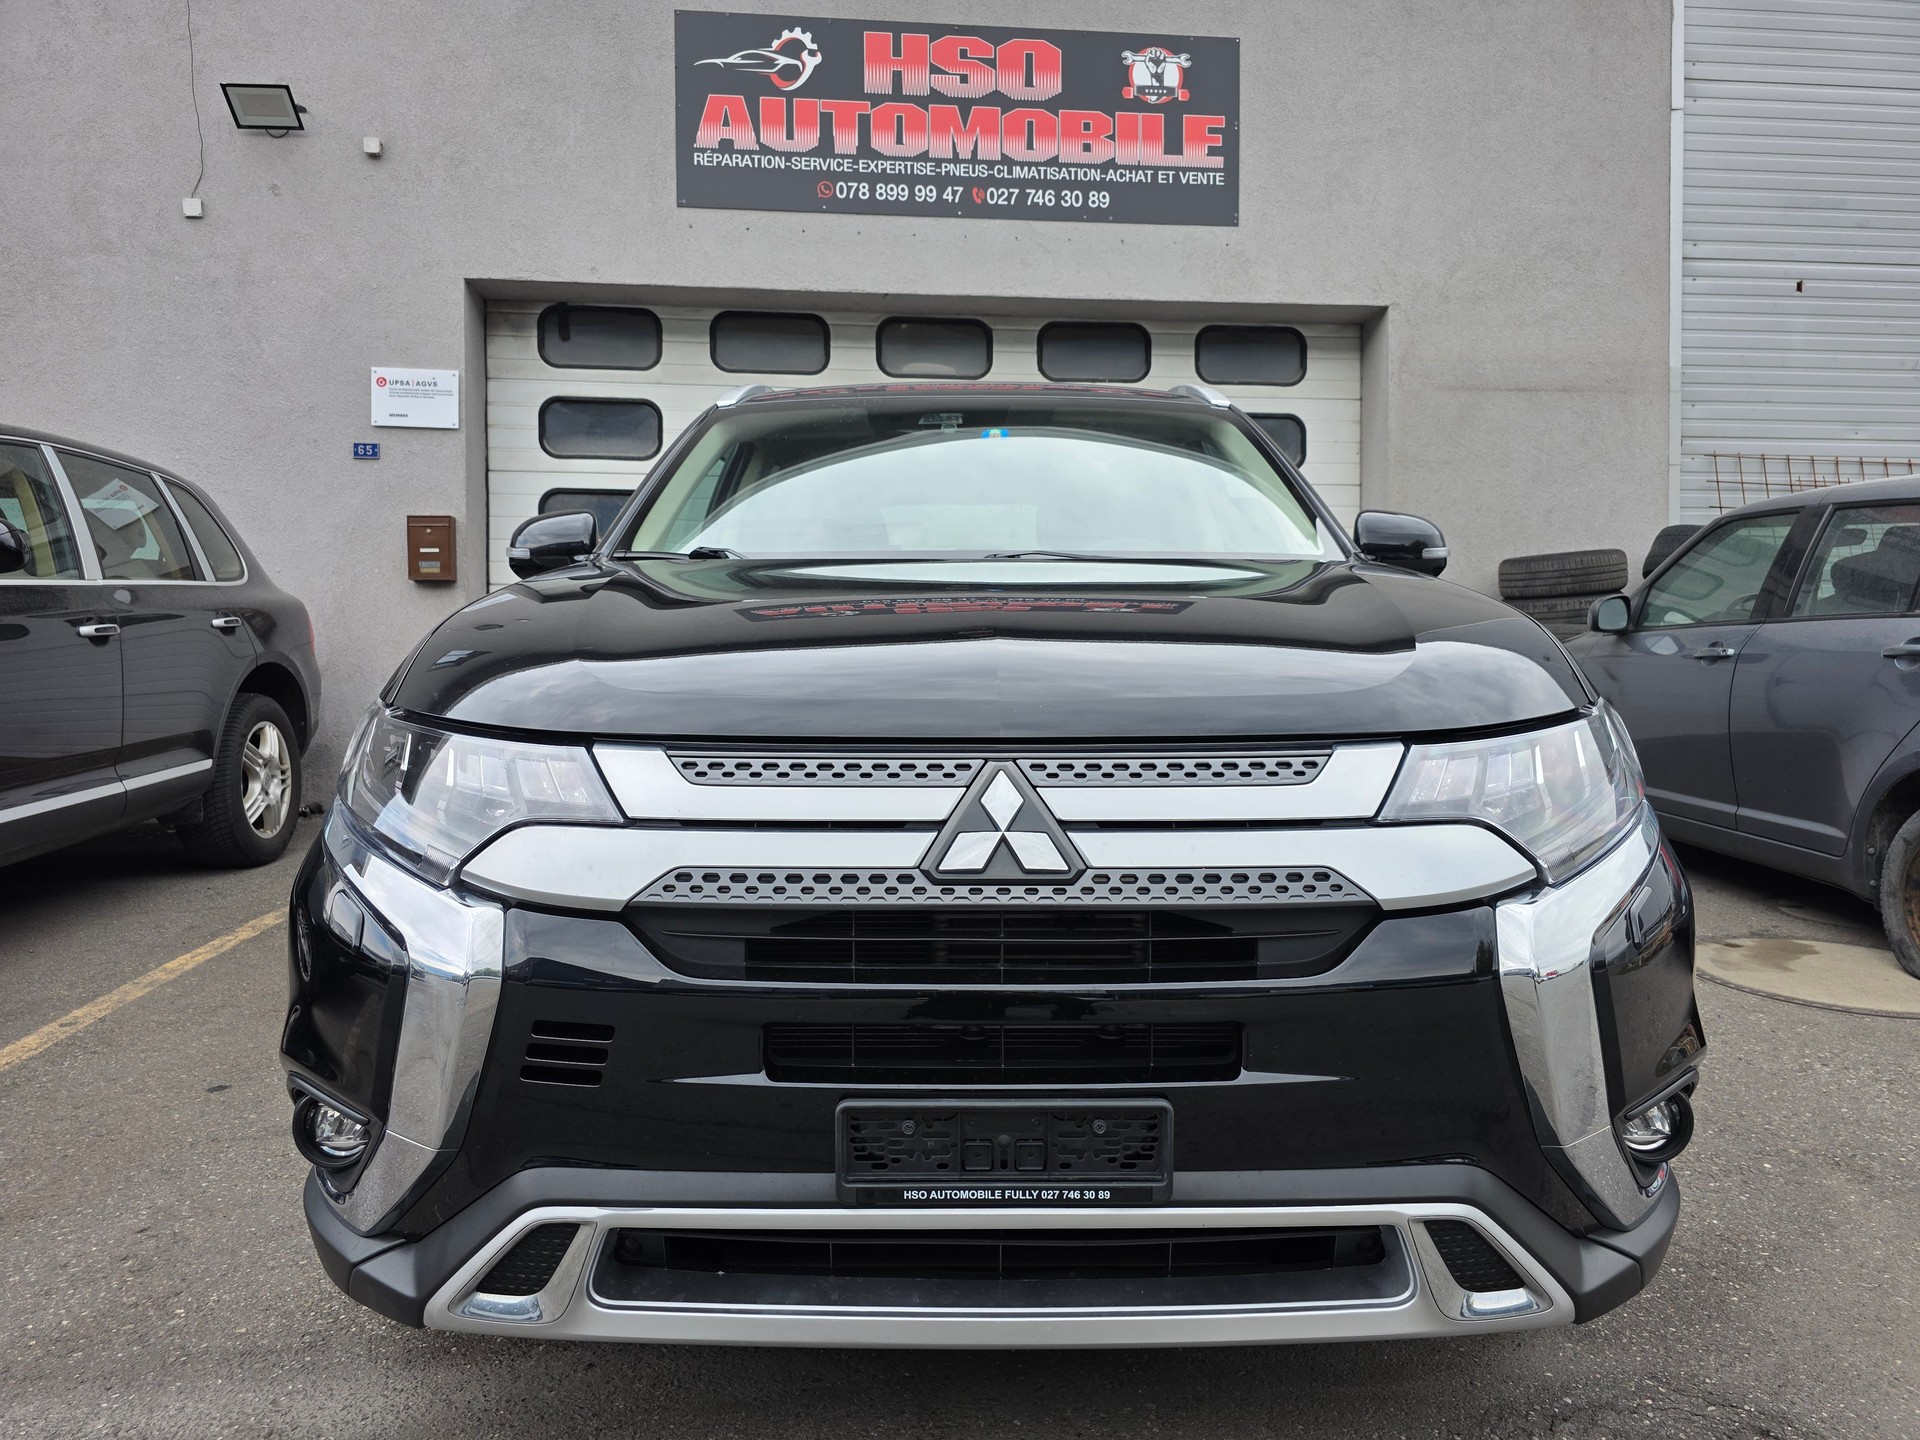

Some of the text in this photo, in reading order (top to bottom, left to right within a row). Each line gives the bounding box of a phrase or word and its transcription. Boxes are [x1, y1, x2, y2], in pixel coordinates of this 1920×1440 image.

[863, 31, 1062, 101] HSO
[693, 94, 1226, 169] AUTOMOBILE
[1158, 171, 1176, 184] ET
[1179, 171, 1225, 186] VENTE
[835, 182, 1111, 208] 078 899 99 47 027 746 30 89
[357, 445, 373, 456] 65
[903, 1190, 1111, 1200] HSO AUTOMOBILE FULLY 027 746 30 89
